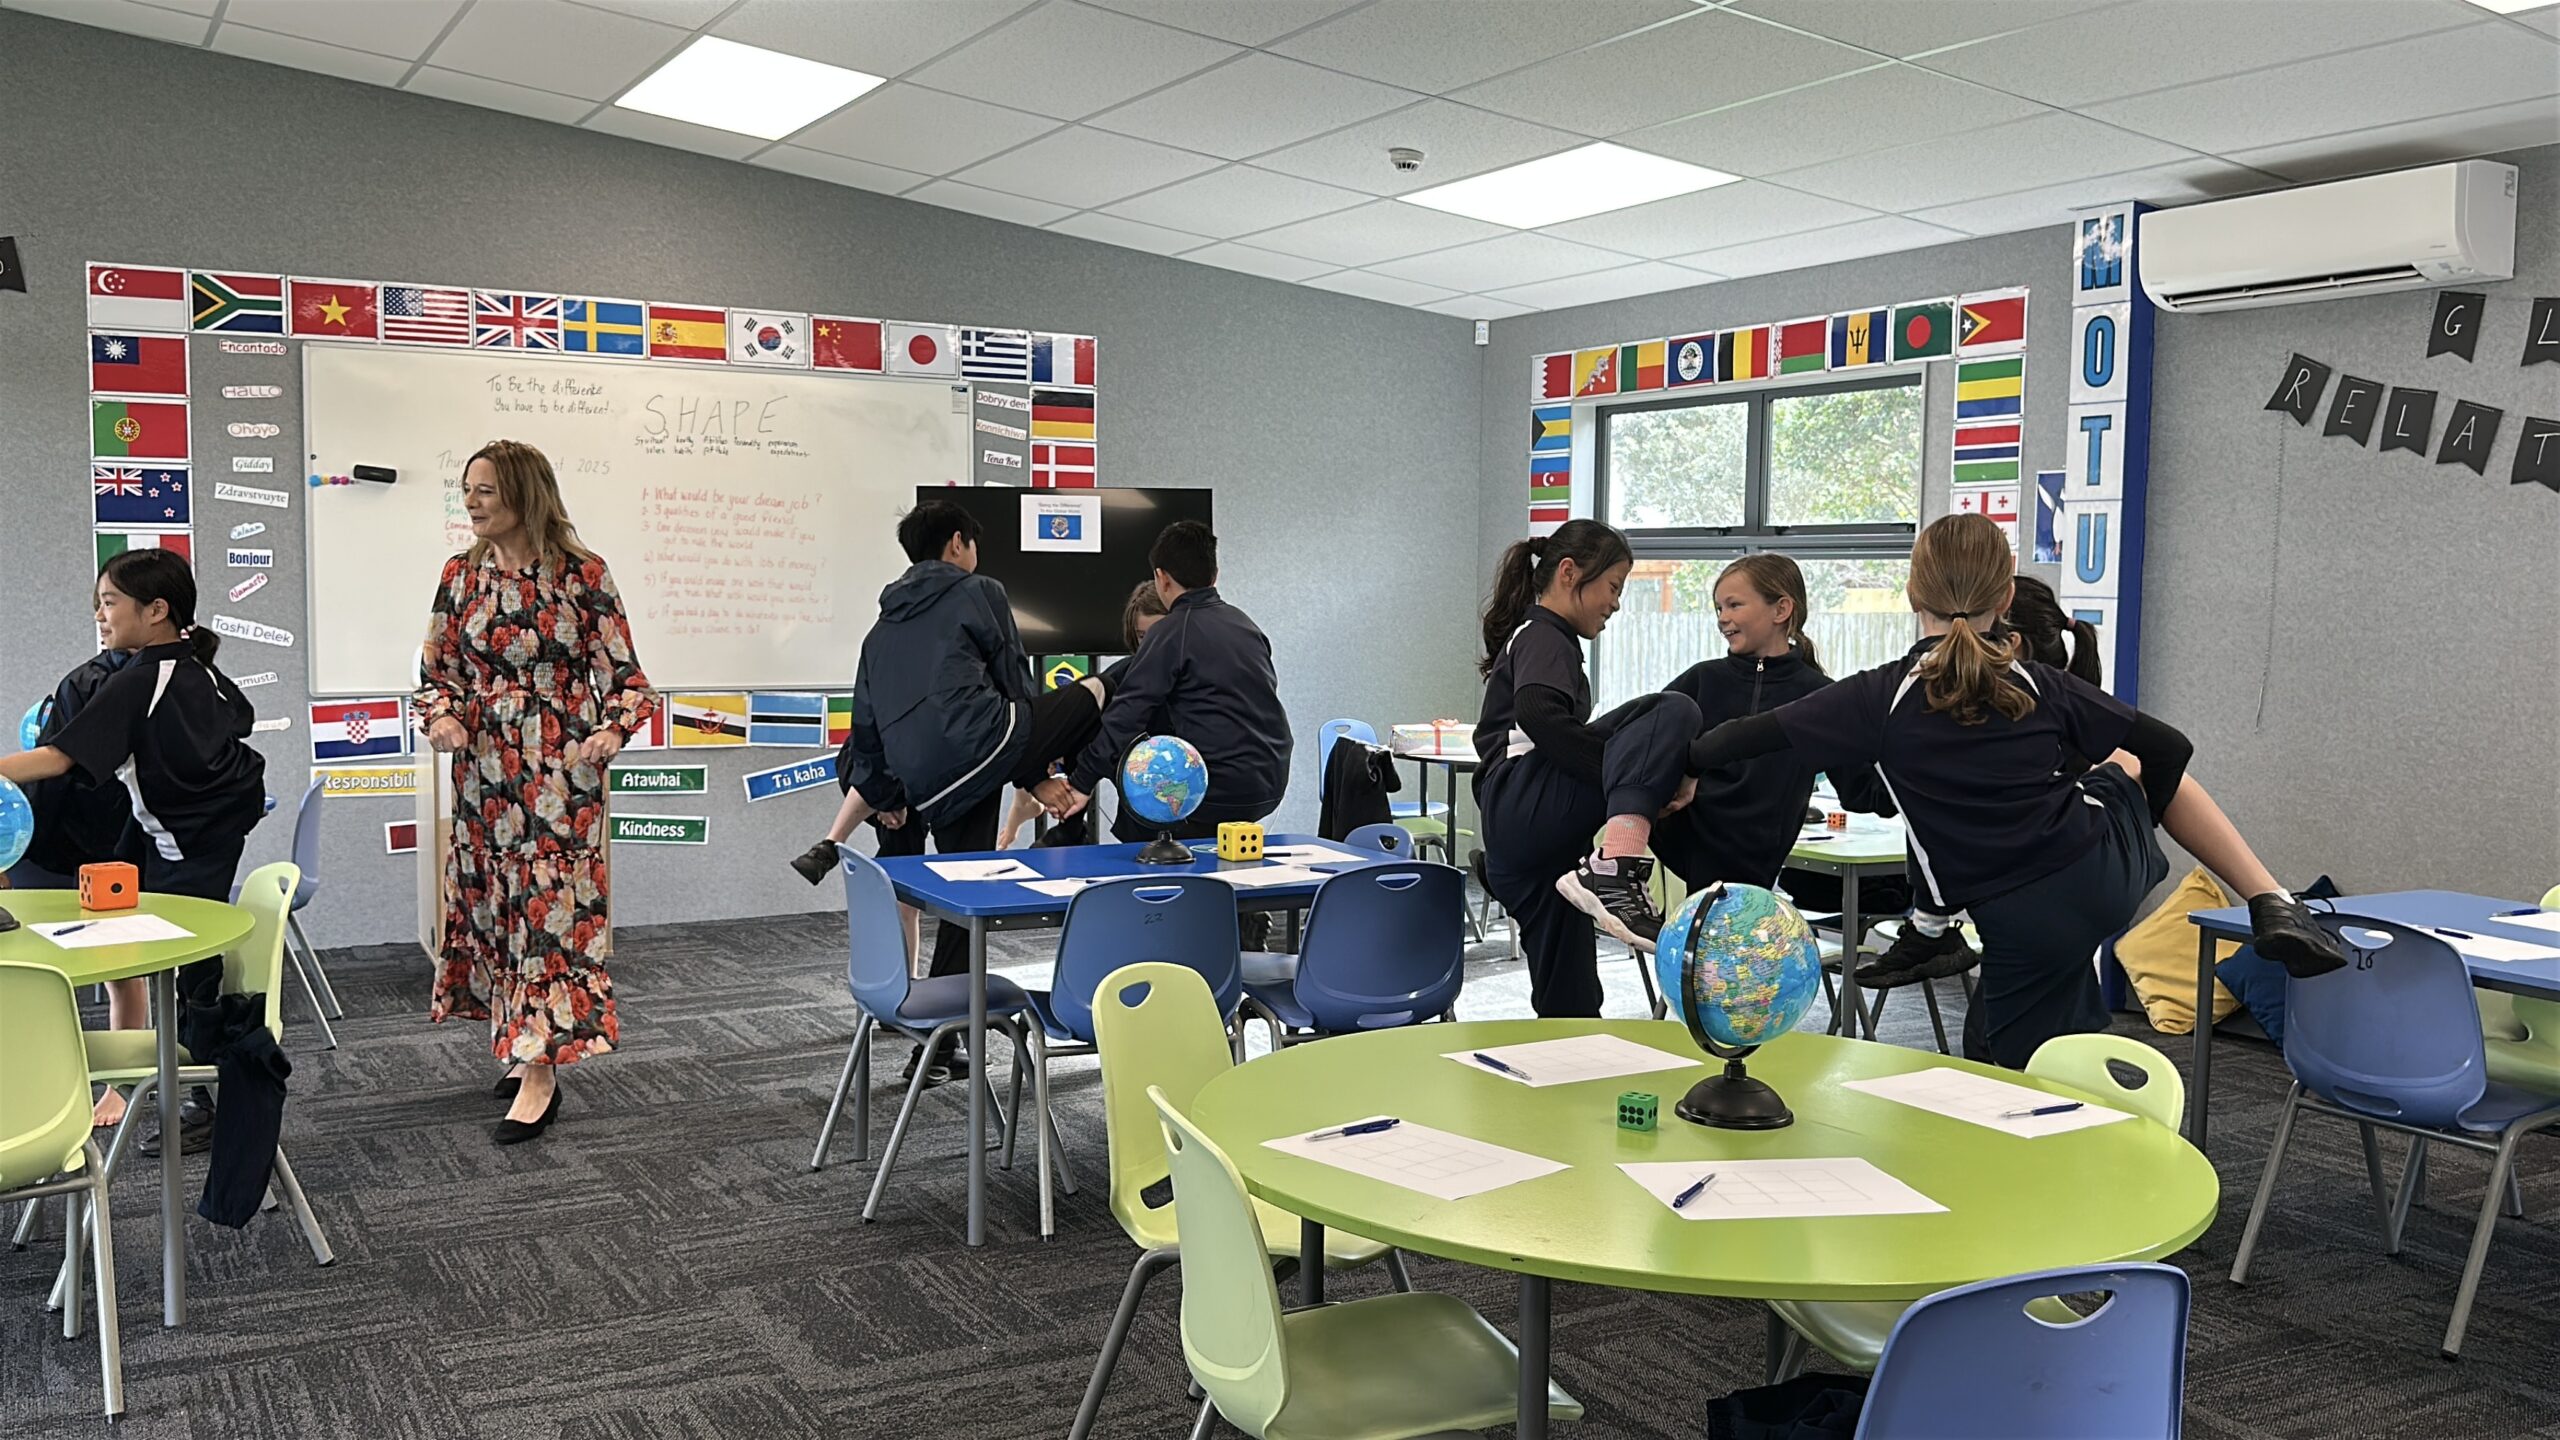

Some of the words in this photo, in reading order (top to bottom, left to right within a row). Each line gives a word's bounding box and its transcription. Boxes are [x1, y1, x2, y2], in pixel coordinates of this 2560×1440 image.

[220, 340, 287, 354] Encantado
[486, 374, 502, 392] To
[527, 377, 546, 394] the
[514, 399, 534, 413] have
[540, 400, 548, 414] to
[553, 400, 565, 414] be
[643, 394, 789, 436] SHAPE
[2072, 213, 2124, 626] MOTU
[976, 421, 1025, 438] Konnichiwa
[577, 458, 611, 475] 2025
[655, 487, 677, 500] What
[681, 488, 707, 502] would
[713, 488, 724, 503] be
[727, 495, 750, 511] your
[754, 492, 784, 508] dream
[785, 493, 808, 513] job
[706, 505, 719, 519] of
[229, 552, 271, 565] Bonjour
[214, 617, 250, 636] Tashi
[253, 626, 291, 643] Delek
[236, 672, 277, 687] amusta
[621, 771, 681, 788] Atawhai
[794, 764, 827, 784] kaha
[618, 820, 685, 838] Kindness
